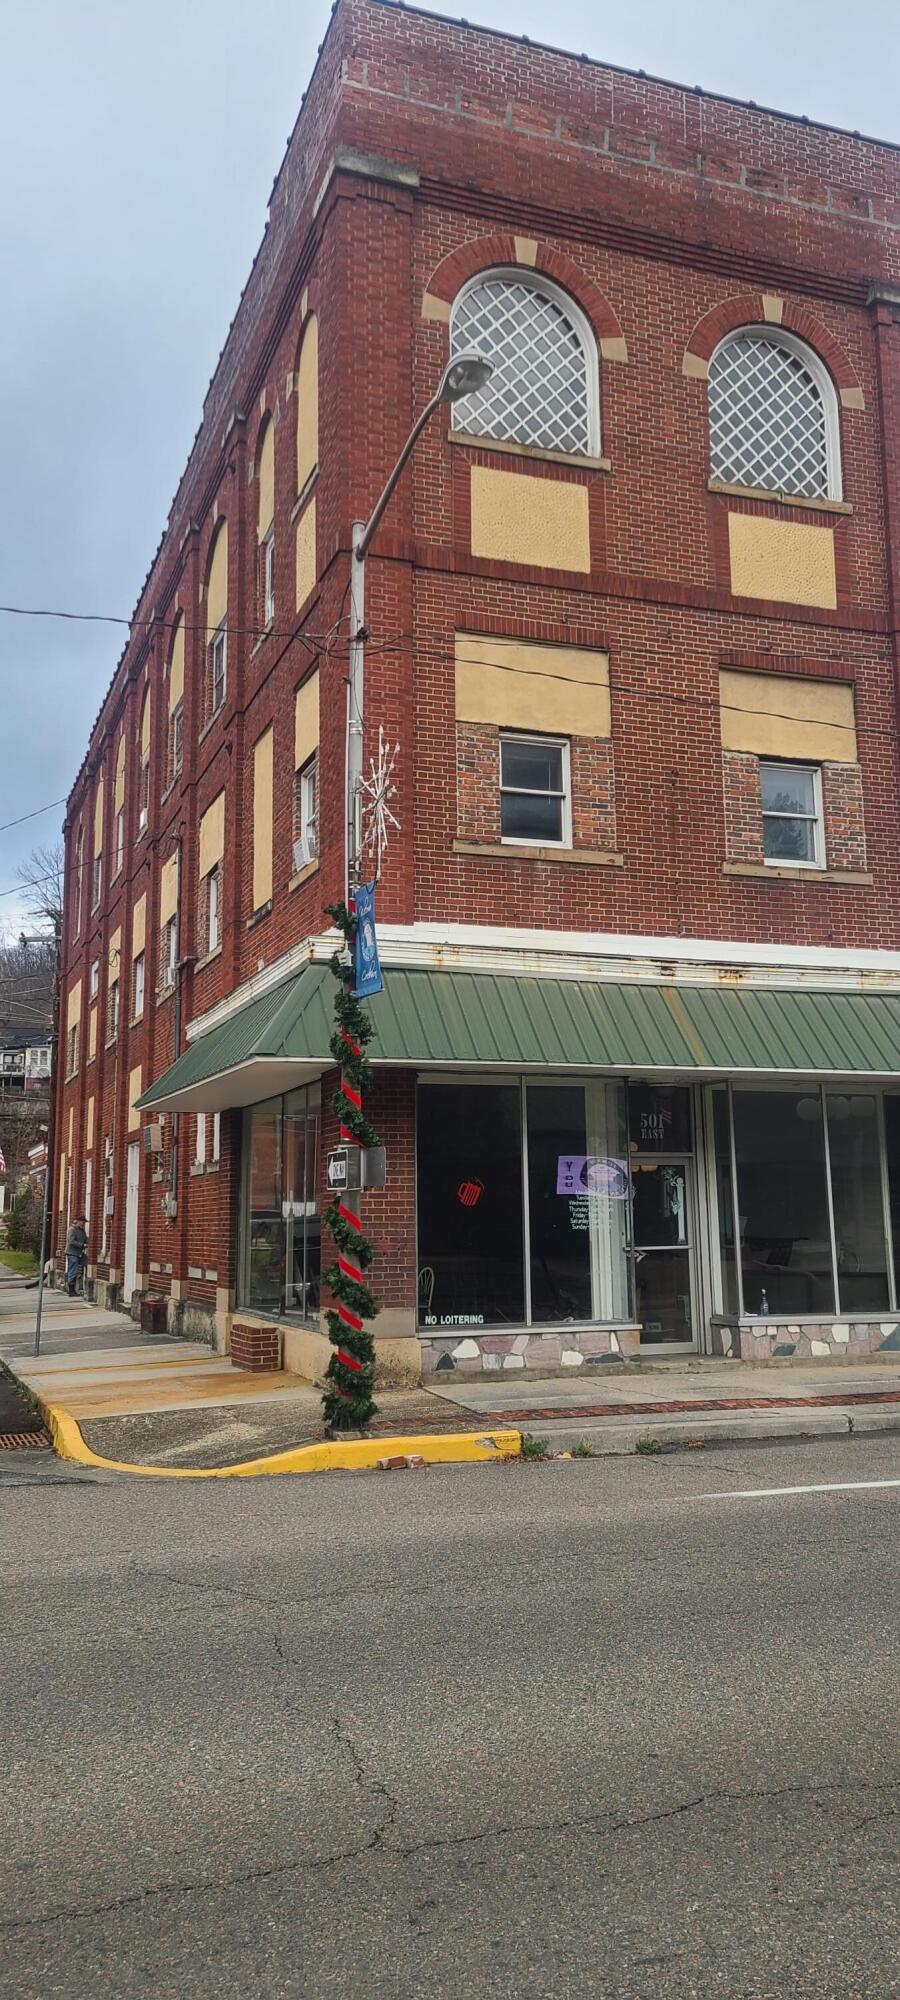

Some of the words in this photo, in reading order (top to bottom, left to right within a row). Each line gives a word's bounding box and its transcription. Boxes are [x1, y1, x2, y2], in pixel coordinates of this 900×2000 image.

[640, 1113, 664, 1128] 501
[640, 1128, 664, 1139] EAST
[425, 1315, 437, 1325] NO
[440, 1314, 484, 1325] LOITERING
